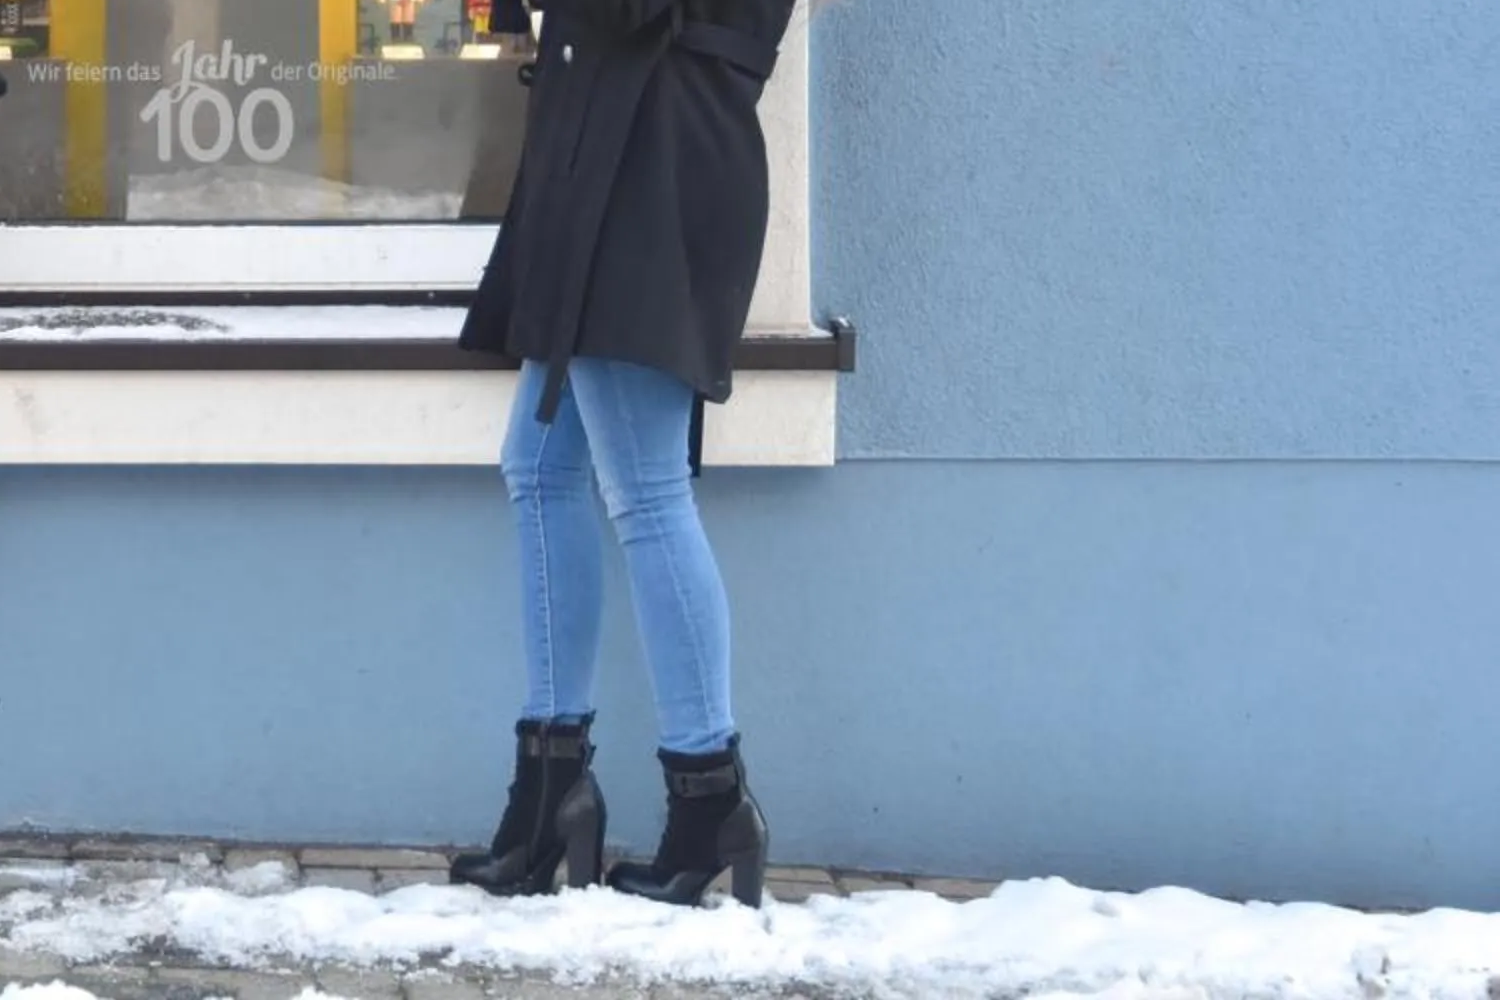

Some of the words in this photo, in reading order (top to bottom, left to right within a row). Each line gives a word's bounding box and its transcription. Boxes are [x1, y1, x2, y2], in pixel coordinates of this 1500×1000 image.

[28, 63, 60, 81] Wir
[66, 62, 121, 81] feiern
[127, 62, 161, 81] das
[171, 39, 268, 100] Jahr
[271, 62, 303, 81] der
[140, 88, 294, 163] 100
